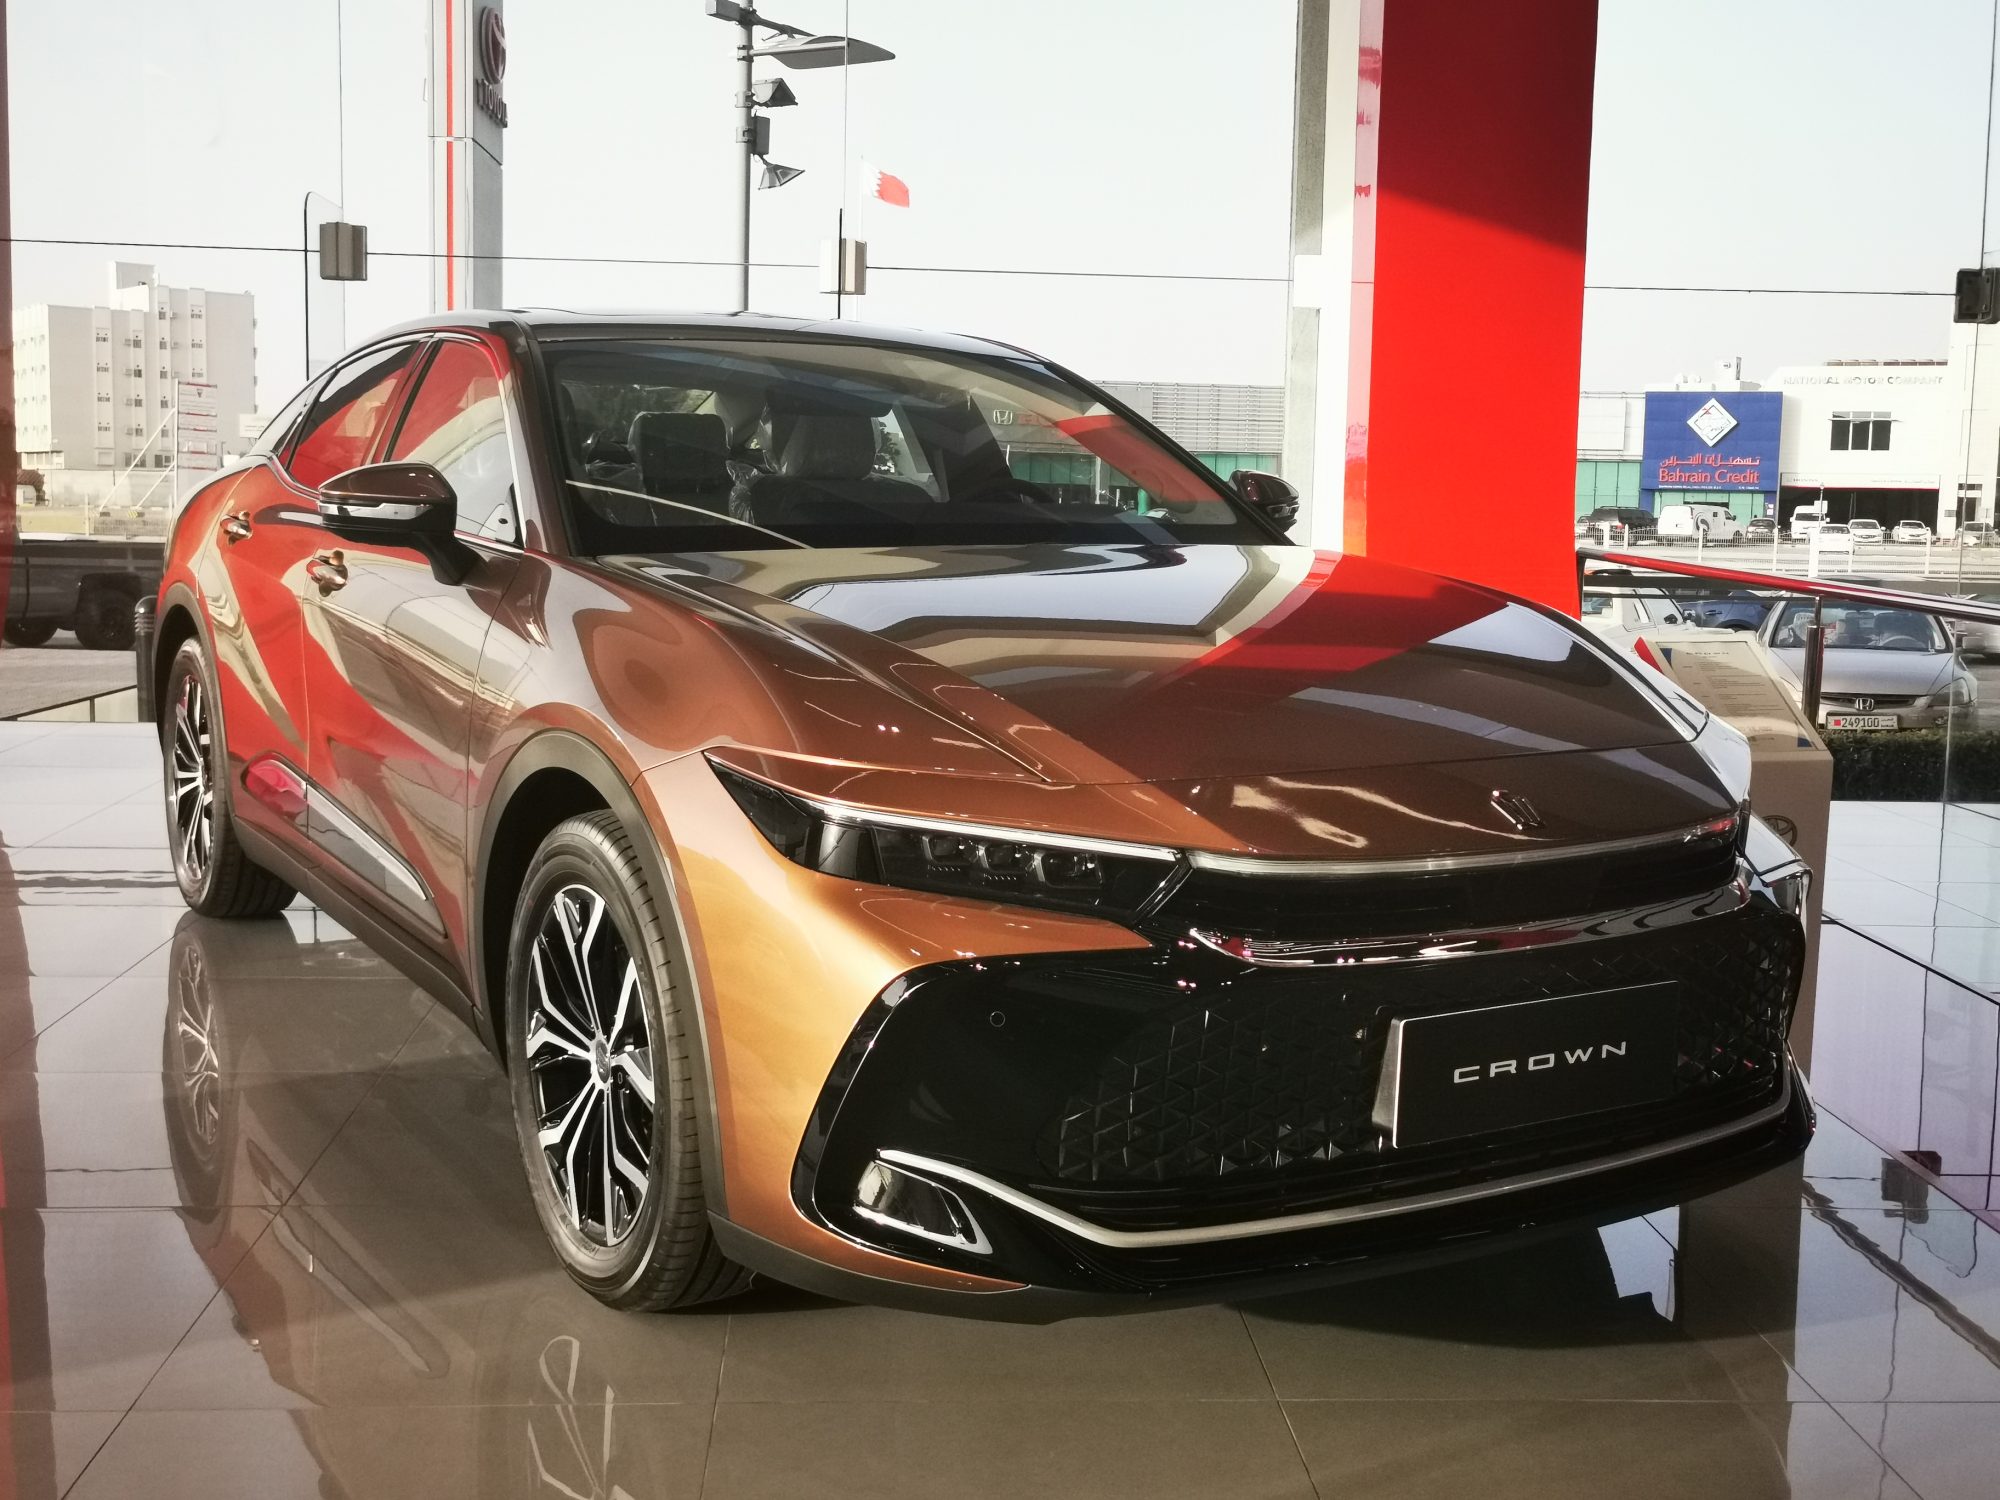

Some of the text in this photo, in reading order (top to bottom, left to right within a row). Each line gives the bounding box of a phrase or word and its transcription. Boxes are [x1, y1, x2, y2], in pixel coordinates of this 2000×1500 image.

[1658, 468, 1760, 484] Bahrain Credit
[1841, 717, 1880, 728] 249100
[1453, 1041, 1627, 1084] CROWN
